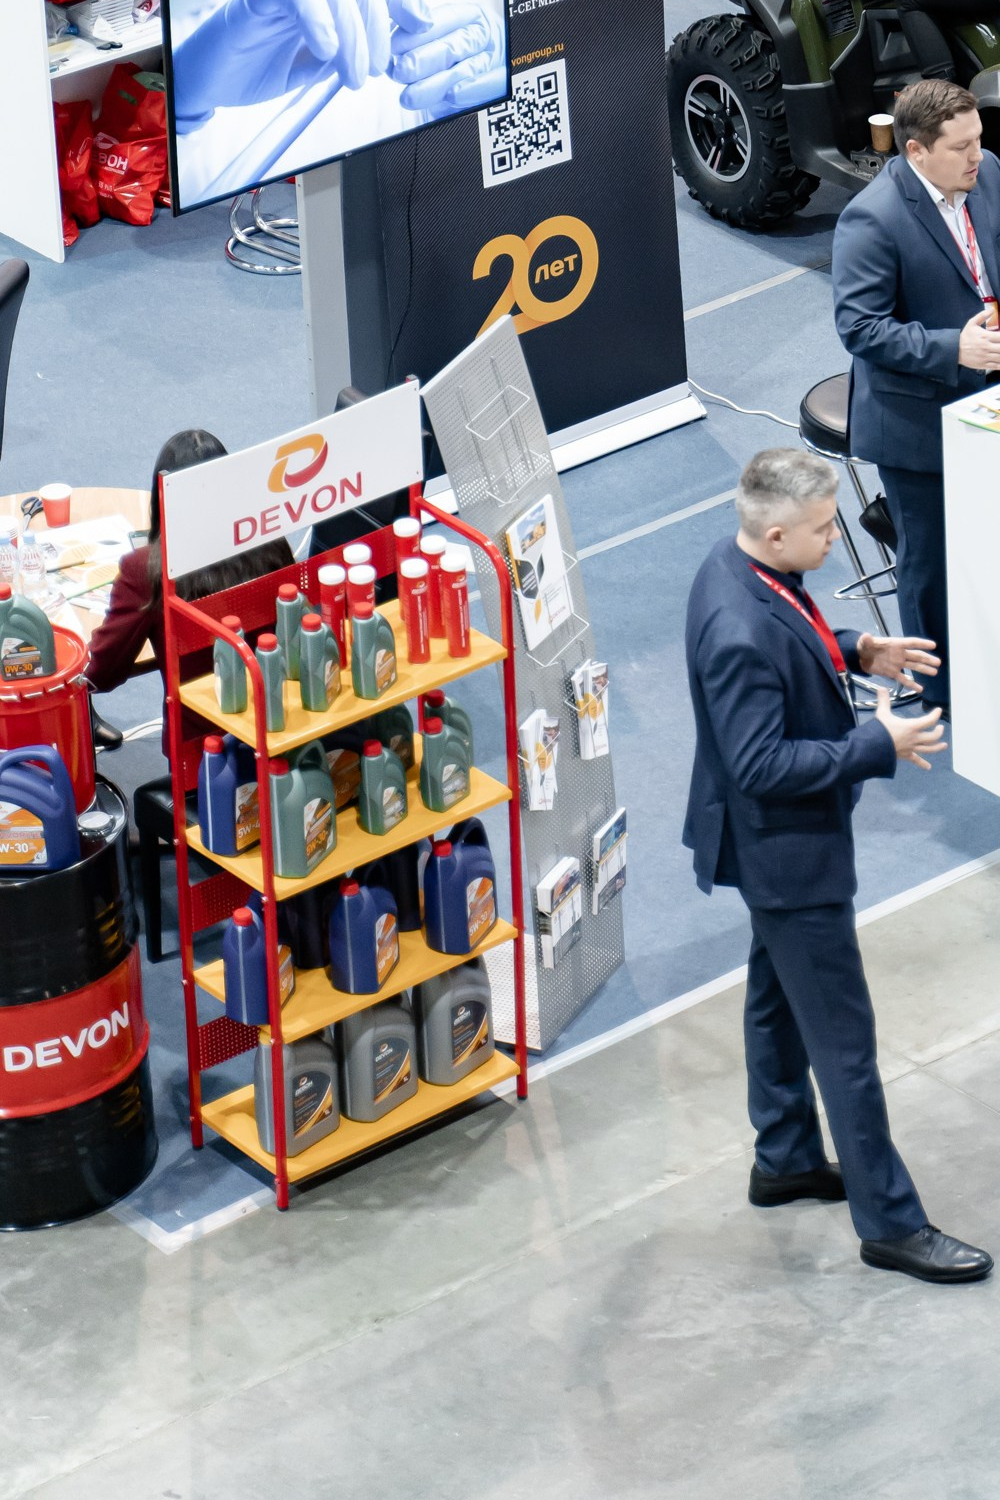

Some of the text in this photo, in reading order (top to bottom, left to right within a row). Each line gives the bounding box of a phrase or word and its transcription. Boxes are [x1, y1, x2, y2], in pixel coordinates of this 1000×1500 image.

[472, 215, 599, 341] 20
[534, 253, 579, 284] лет
[233, 470, 363, 547] DEVON
[5, 663, 33, 674] 0W-30
[238, 820, 260, 838] 5W-4
[4, 1002, 130, 1073] DEVON
